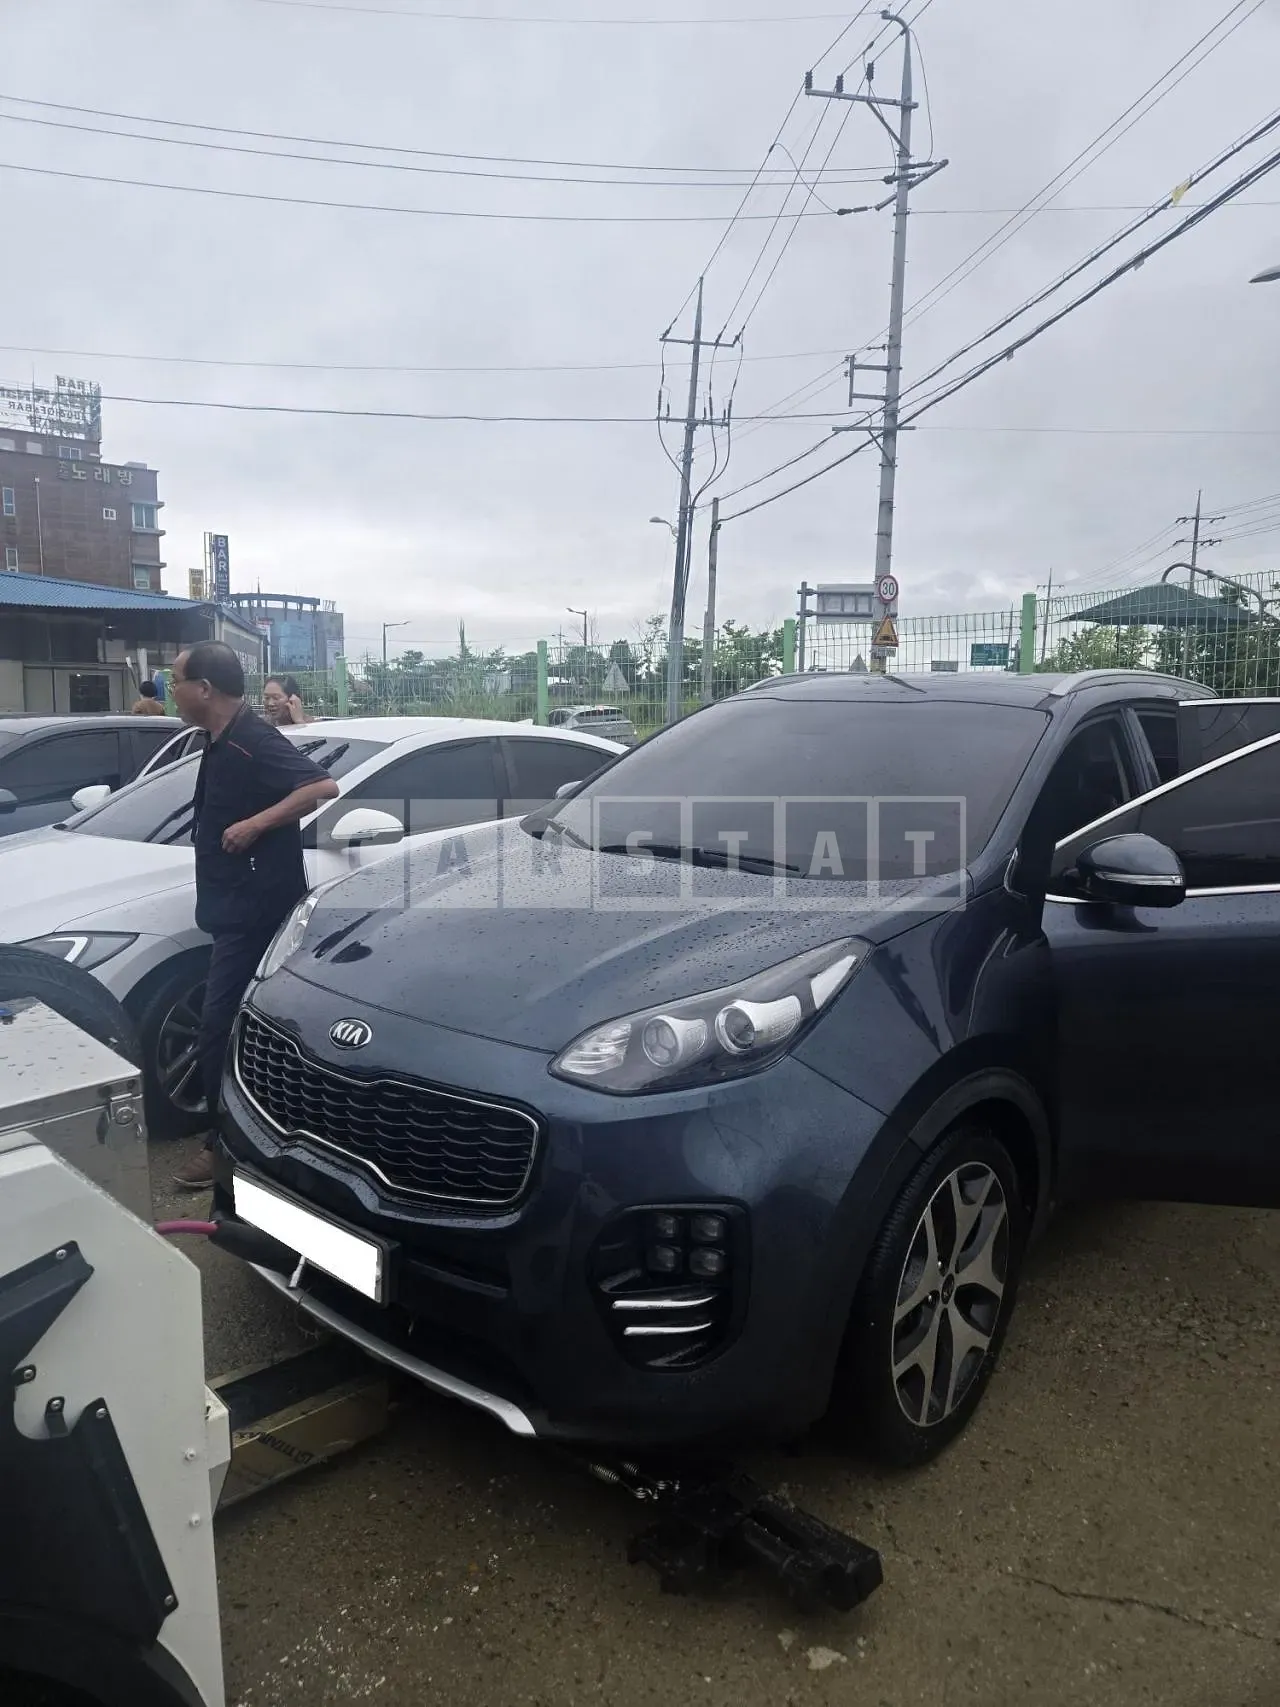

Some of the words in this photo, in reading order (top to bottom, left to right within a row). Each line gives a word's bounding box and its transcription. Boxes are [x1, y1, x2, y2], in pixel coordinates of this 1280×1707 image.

[57, 377, 86, 390] BAR
[71, 463, 133, 486] 노래방
[217, 536, 228, 573] BAR
[882, 582, 895, 596] 30
[332, 1021, 364, 1045] KIA
